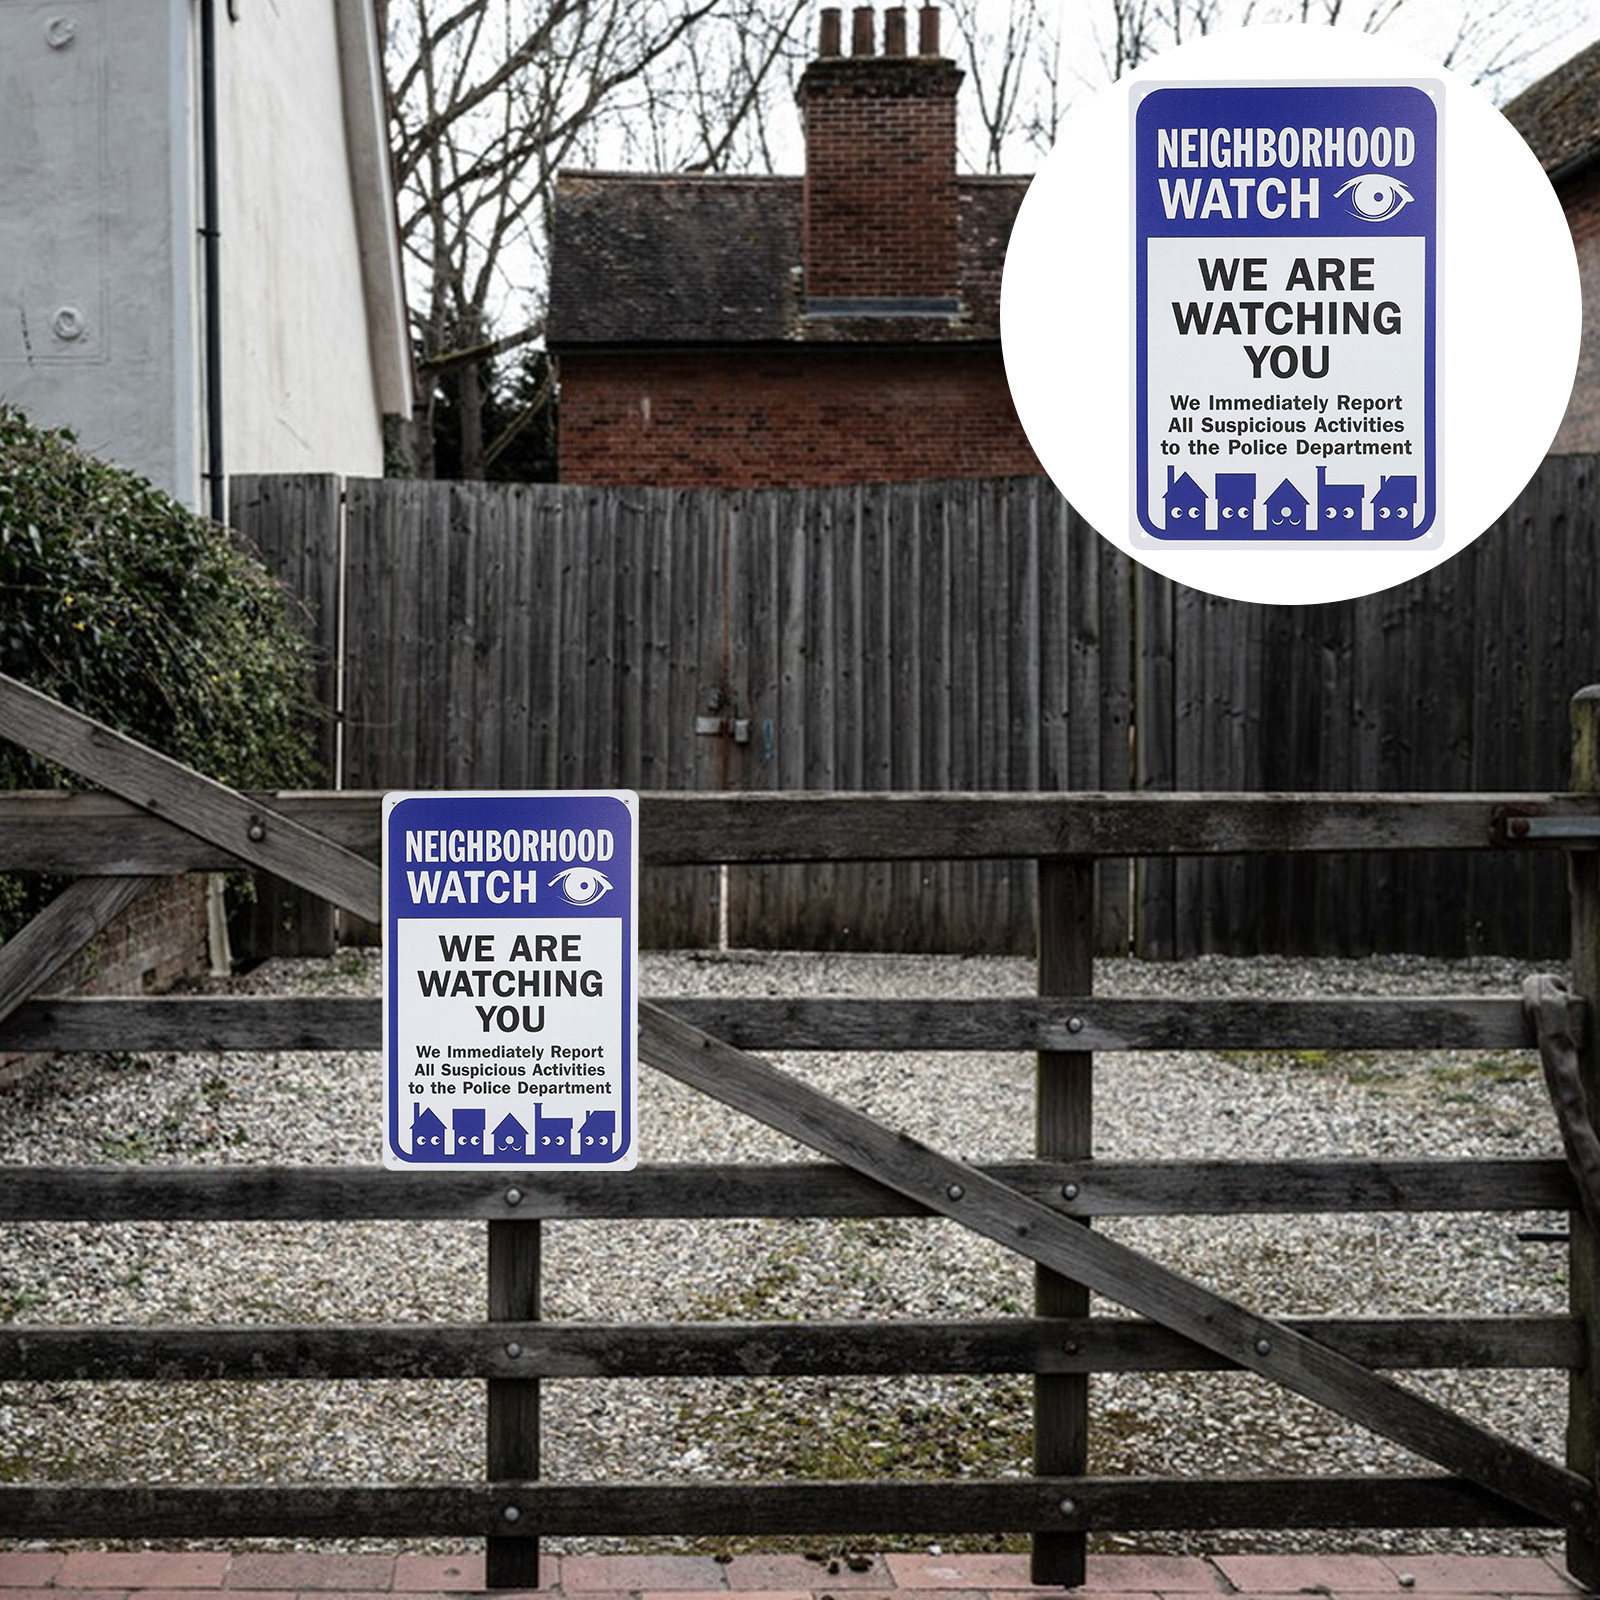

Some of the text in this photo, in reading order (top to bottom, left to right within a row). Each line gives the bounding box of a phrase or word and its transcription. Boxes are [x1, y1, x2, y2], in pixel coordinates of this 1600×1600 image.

[1157, 126, 1416, 169] NEIGHBORHOOD
[1158, 177, 1320, 220] WATCH
[1197, 257, 1375, 292] WE ARE
[1171, 301, 1401, 336] WATCHING
[1243, 345, 1330, 379] YOU
[1169, 394, 1403, 415] We Immediately Report
[1168, 416, 1405, 437] All Suspicious Activities
[1160, 439, 1413, 459] to the Police Department
[405, 828, 614, 863] NEIGHBORHOOD
[406, 869, 537, 904] WATCH
[438, 934, 582, 962] WE ARE
[416, 969, 603, 998] WATCHING
[474, 1005, 545, 1033] YOU
[415, 1045, 604, 1062] We Immediately Report
[414, 1062, 606, 1080] All Suspicious Activities
[408, 1081, 612, 1098] to the Police Department
